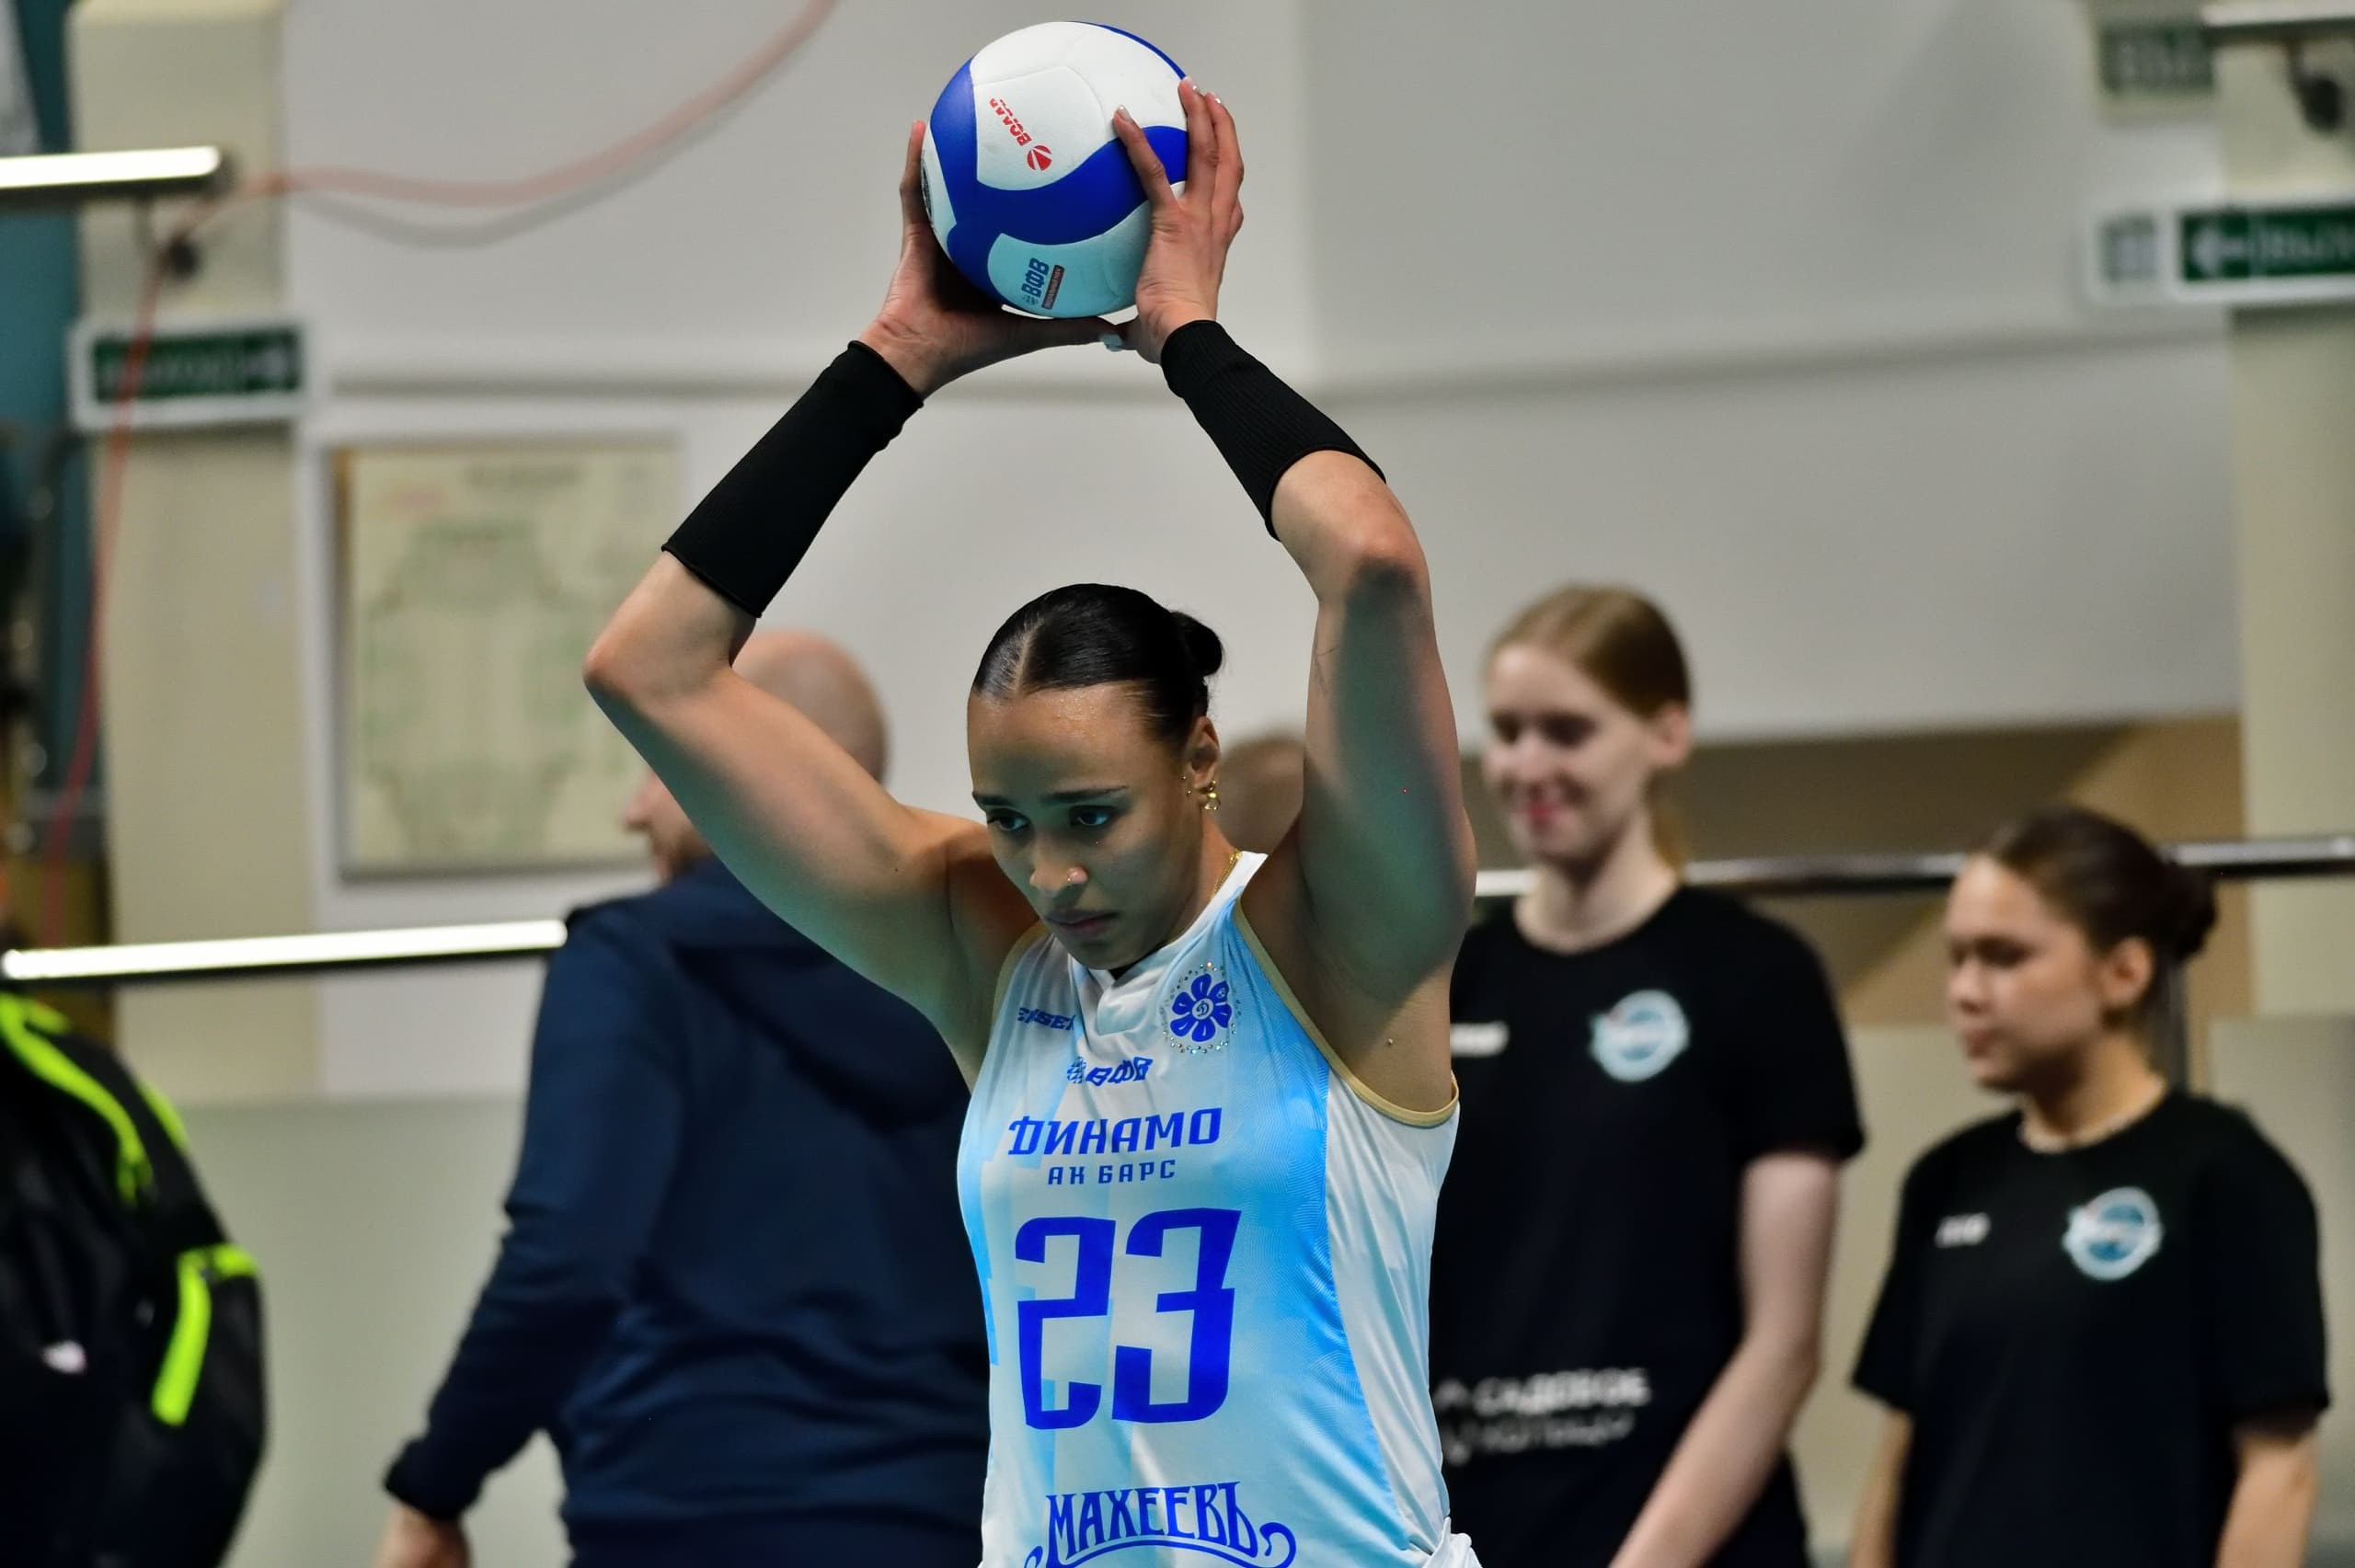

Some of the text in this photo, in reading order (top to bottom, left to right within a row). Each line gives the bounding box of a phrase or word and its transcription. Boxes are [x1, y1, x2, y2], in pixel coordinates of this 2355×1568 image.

[1021, 258, 1050, 298] ВФВ
[1085, 1056, 1154, 1086] ВФВ
[1008, 1107, 1222, 1155] ДИНАМО
[1048, 1160, 1176, 1185] АК БАРС
[1015, 1207, 1242, 1429] 23
[1045, 1481, 1259, 1567] МАХЕЕВЪ
